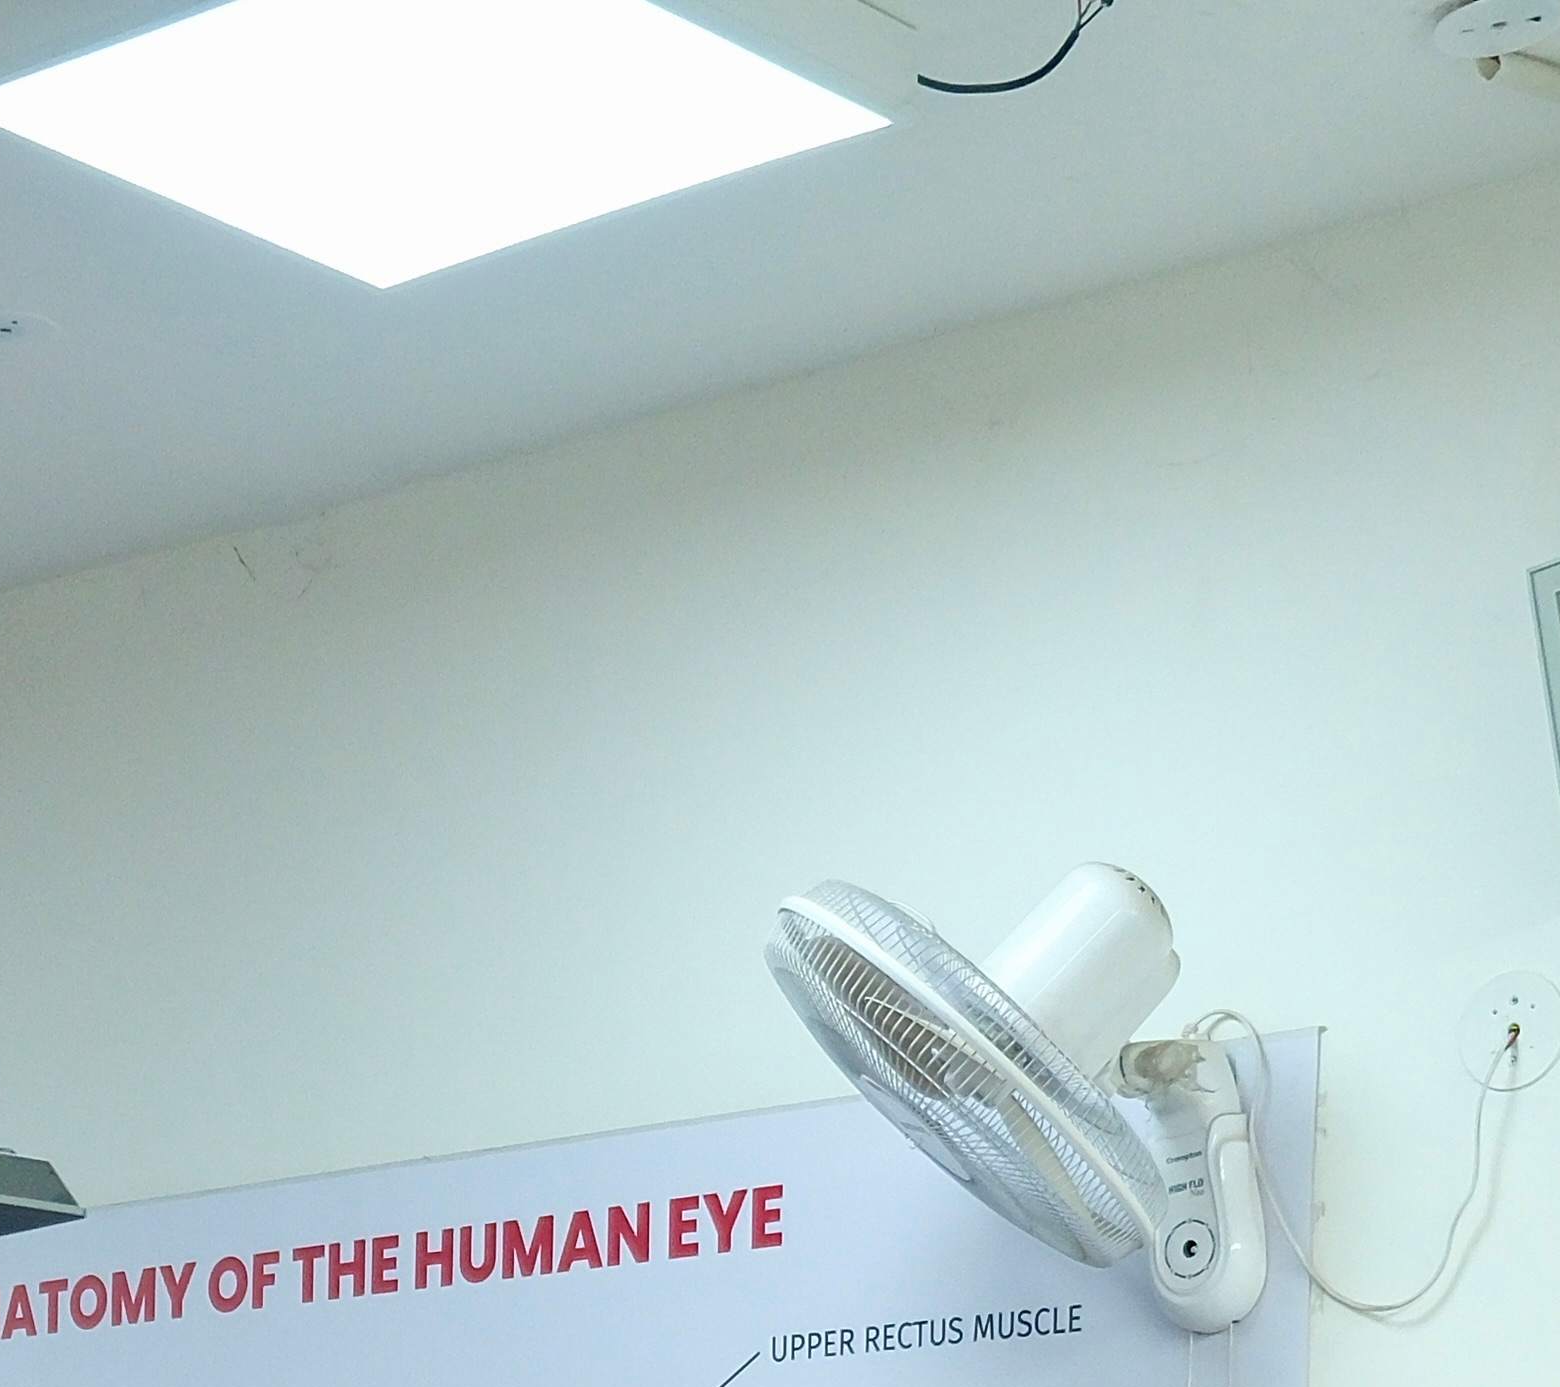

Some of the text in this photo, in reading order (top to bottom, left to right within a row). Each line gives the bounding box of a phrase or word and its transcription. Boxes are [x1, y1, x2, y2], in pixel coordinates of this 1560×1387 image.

[208, 1250, 282, 1312] OF
[294, 1233, 403, 1302] THE
[413, 1200, 654, 1290] HUMAN
[667, 1181, 787, 1260] EYE
[772, 1304, 1082, 1363] UPPER RECTUS MUSCLE
